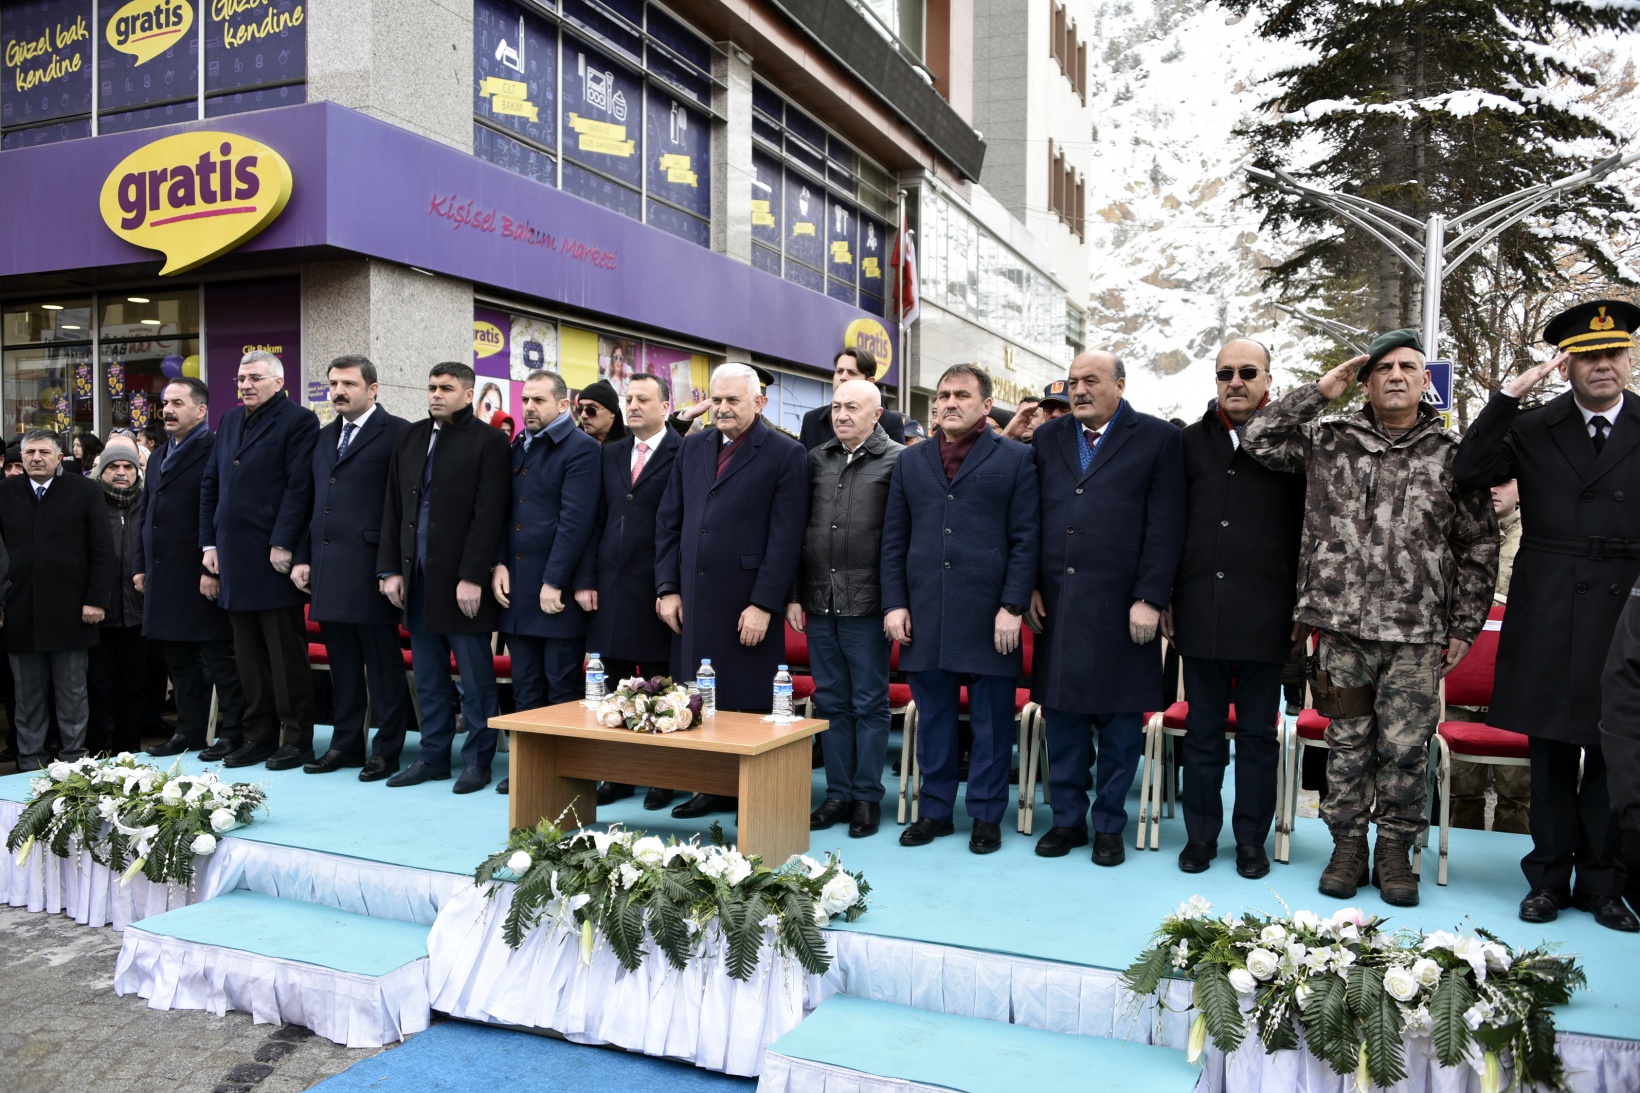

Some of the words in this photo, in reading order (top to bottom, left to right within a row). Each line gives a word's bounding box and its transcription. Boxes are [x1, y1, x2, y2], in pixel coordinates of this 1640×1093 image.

[5, 27, 52, 67] Güzel
[56, 15, 89, 48] bak
[115, 0, 183, 46] gratis
[224, 5, 304, 49] kendine
[16, 53, 82, 92] kendine
[117, 141, 260, 230] gratis
[429, 194, 496, 232] Kişisel
[501, 214, 557, 250] Bakım
[560, 236, 617, 271] Marketi
[474, 327, 500, 344] ratis
